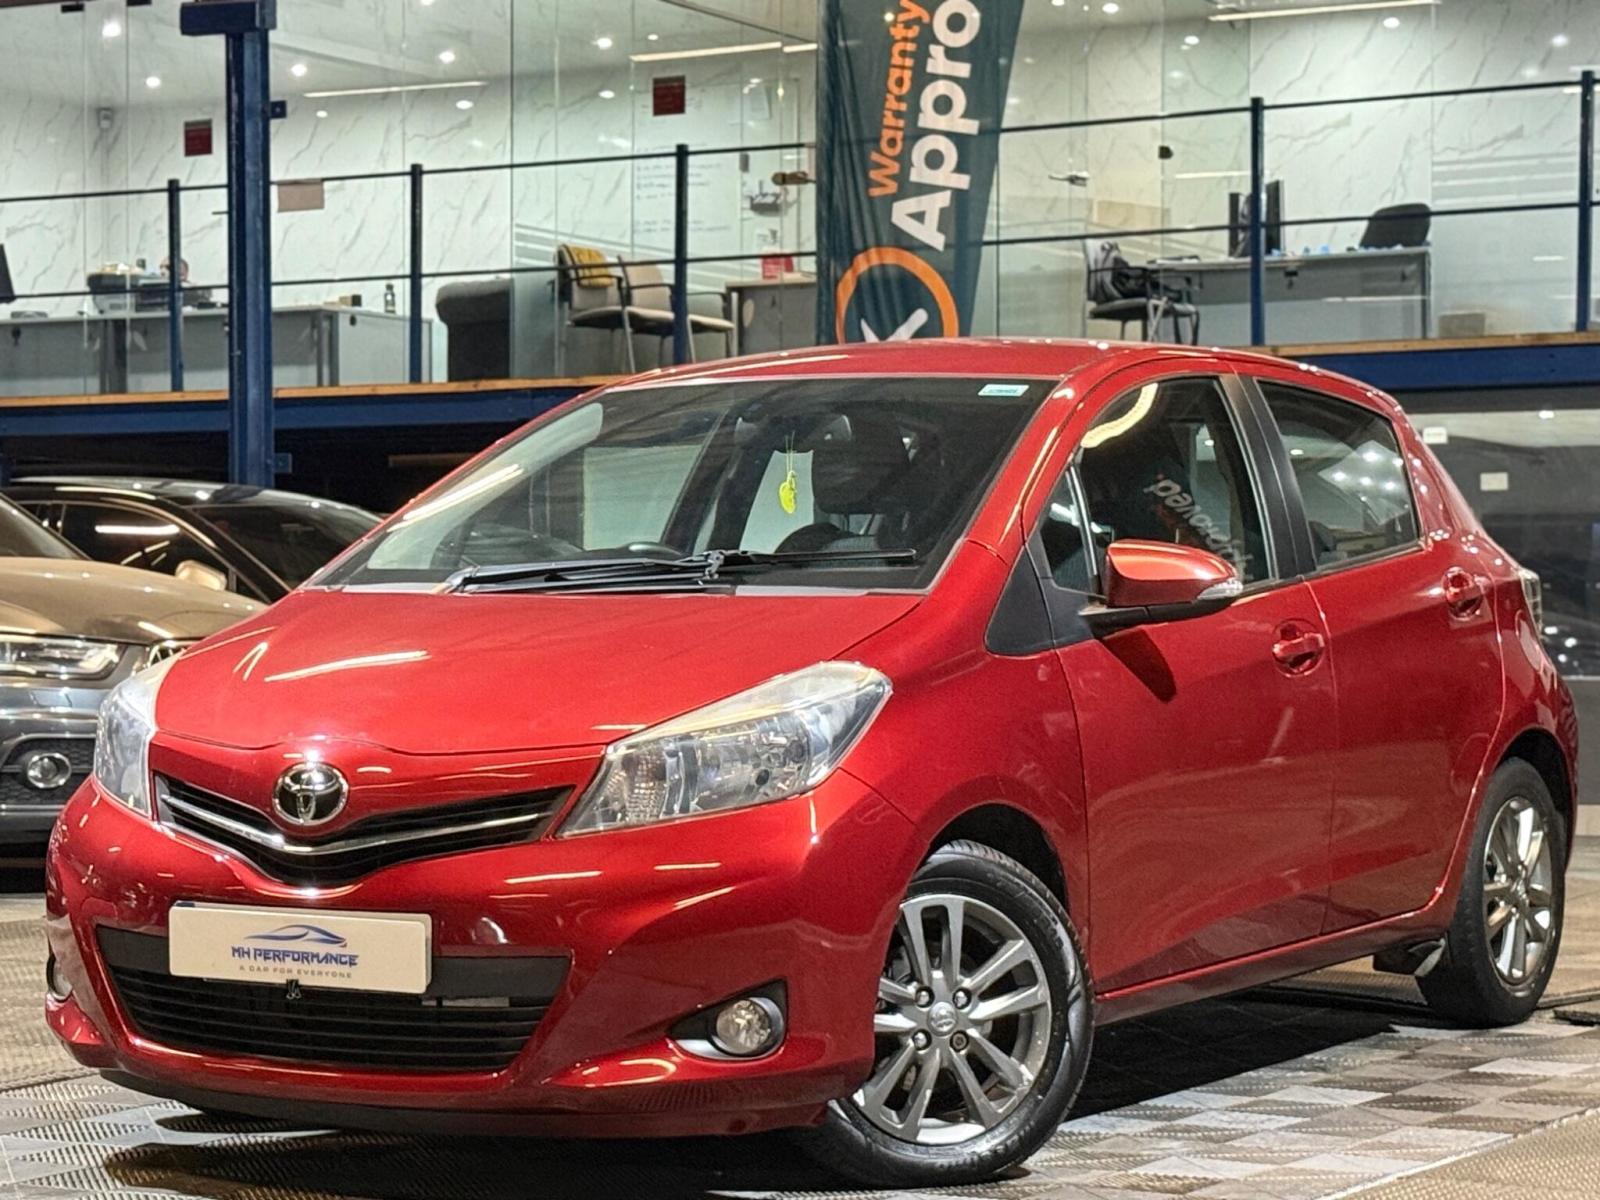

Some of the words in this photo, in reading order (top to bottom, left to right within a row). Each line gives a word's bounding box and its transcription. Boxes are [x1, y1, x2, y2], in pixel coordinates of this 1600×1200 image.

[867, 0, 930, 197] Warranty
[231, 946, 251, 961] MH
[253, 947, 359, 968] PERFORMANCE
[249, 965, 269, 973] CAR
[273, 966, 293, 974] FOR
[297, 968, 352, 979] EVERYONE
